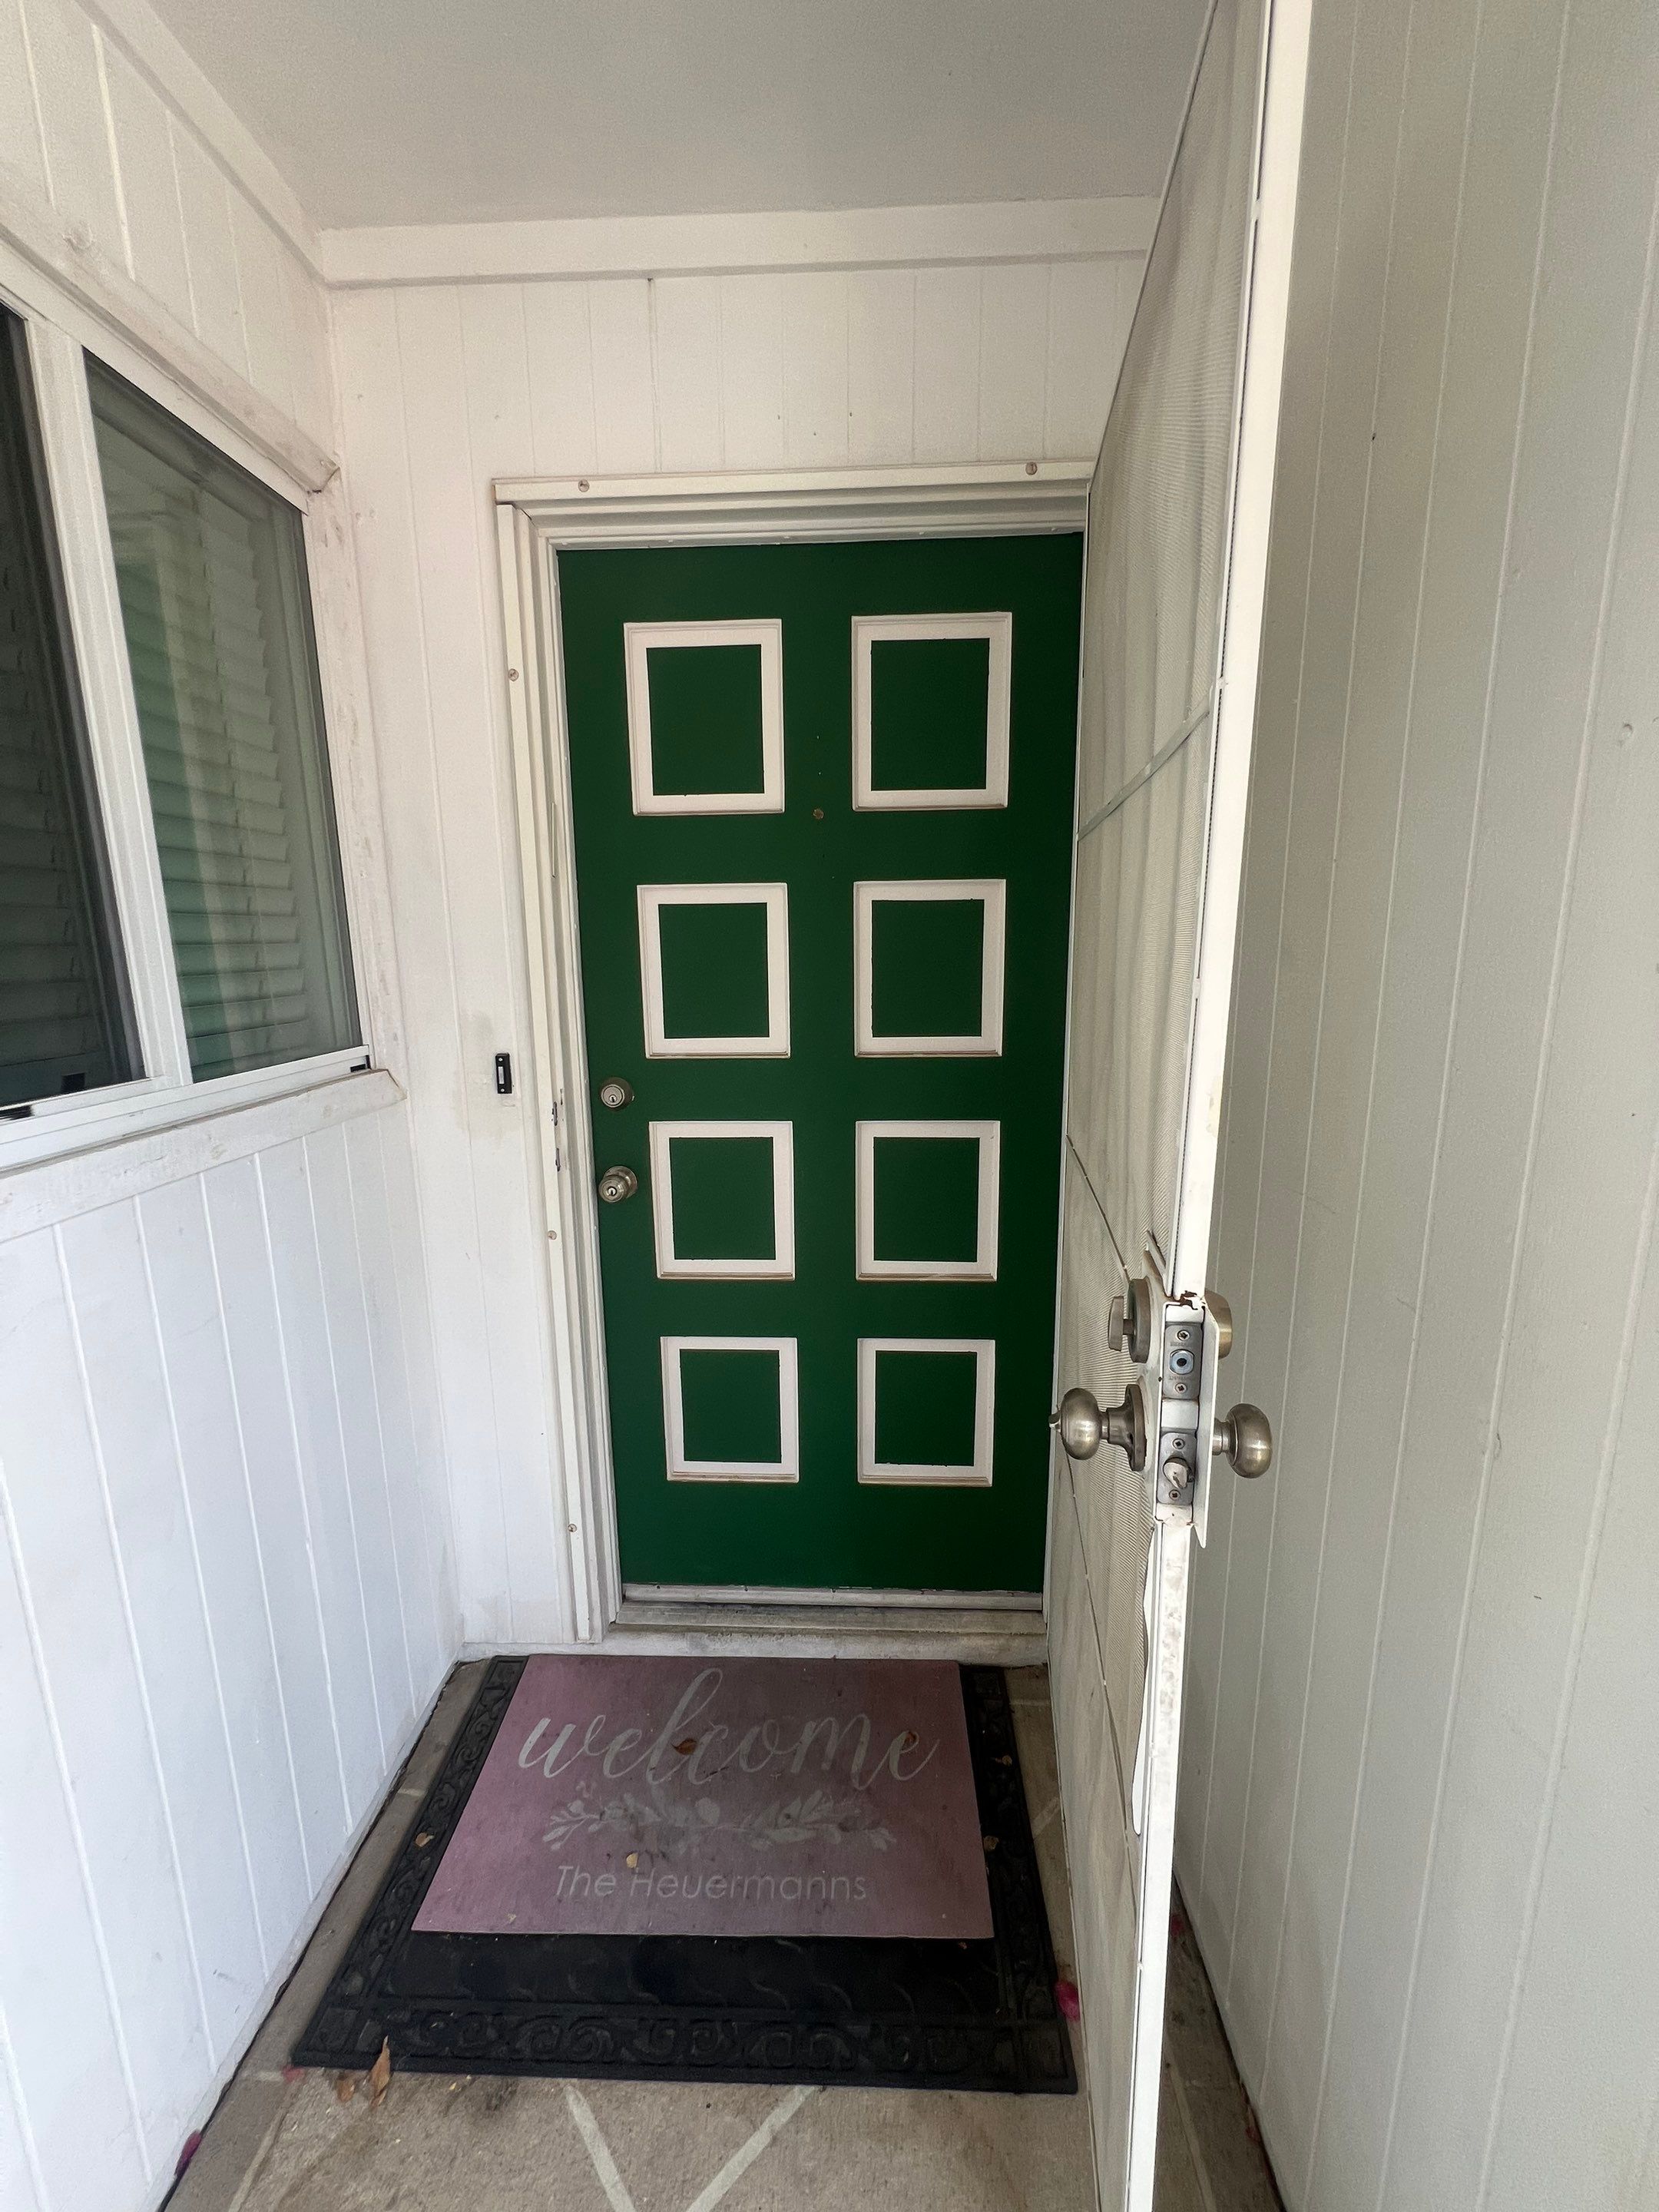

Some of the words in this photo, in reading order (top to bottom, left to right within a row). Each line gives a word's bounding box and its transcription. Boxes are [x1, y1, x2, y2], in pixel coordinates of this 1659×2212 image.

[518, 1667, 939, 1790] welcome
[555, 1866, 615, 1896] The
[630, 1868, 866, 1899] Heuermanns
